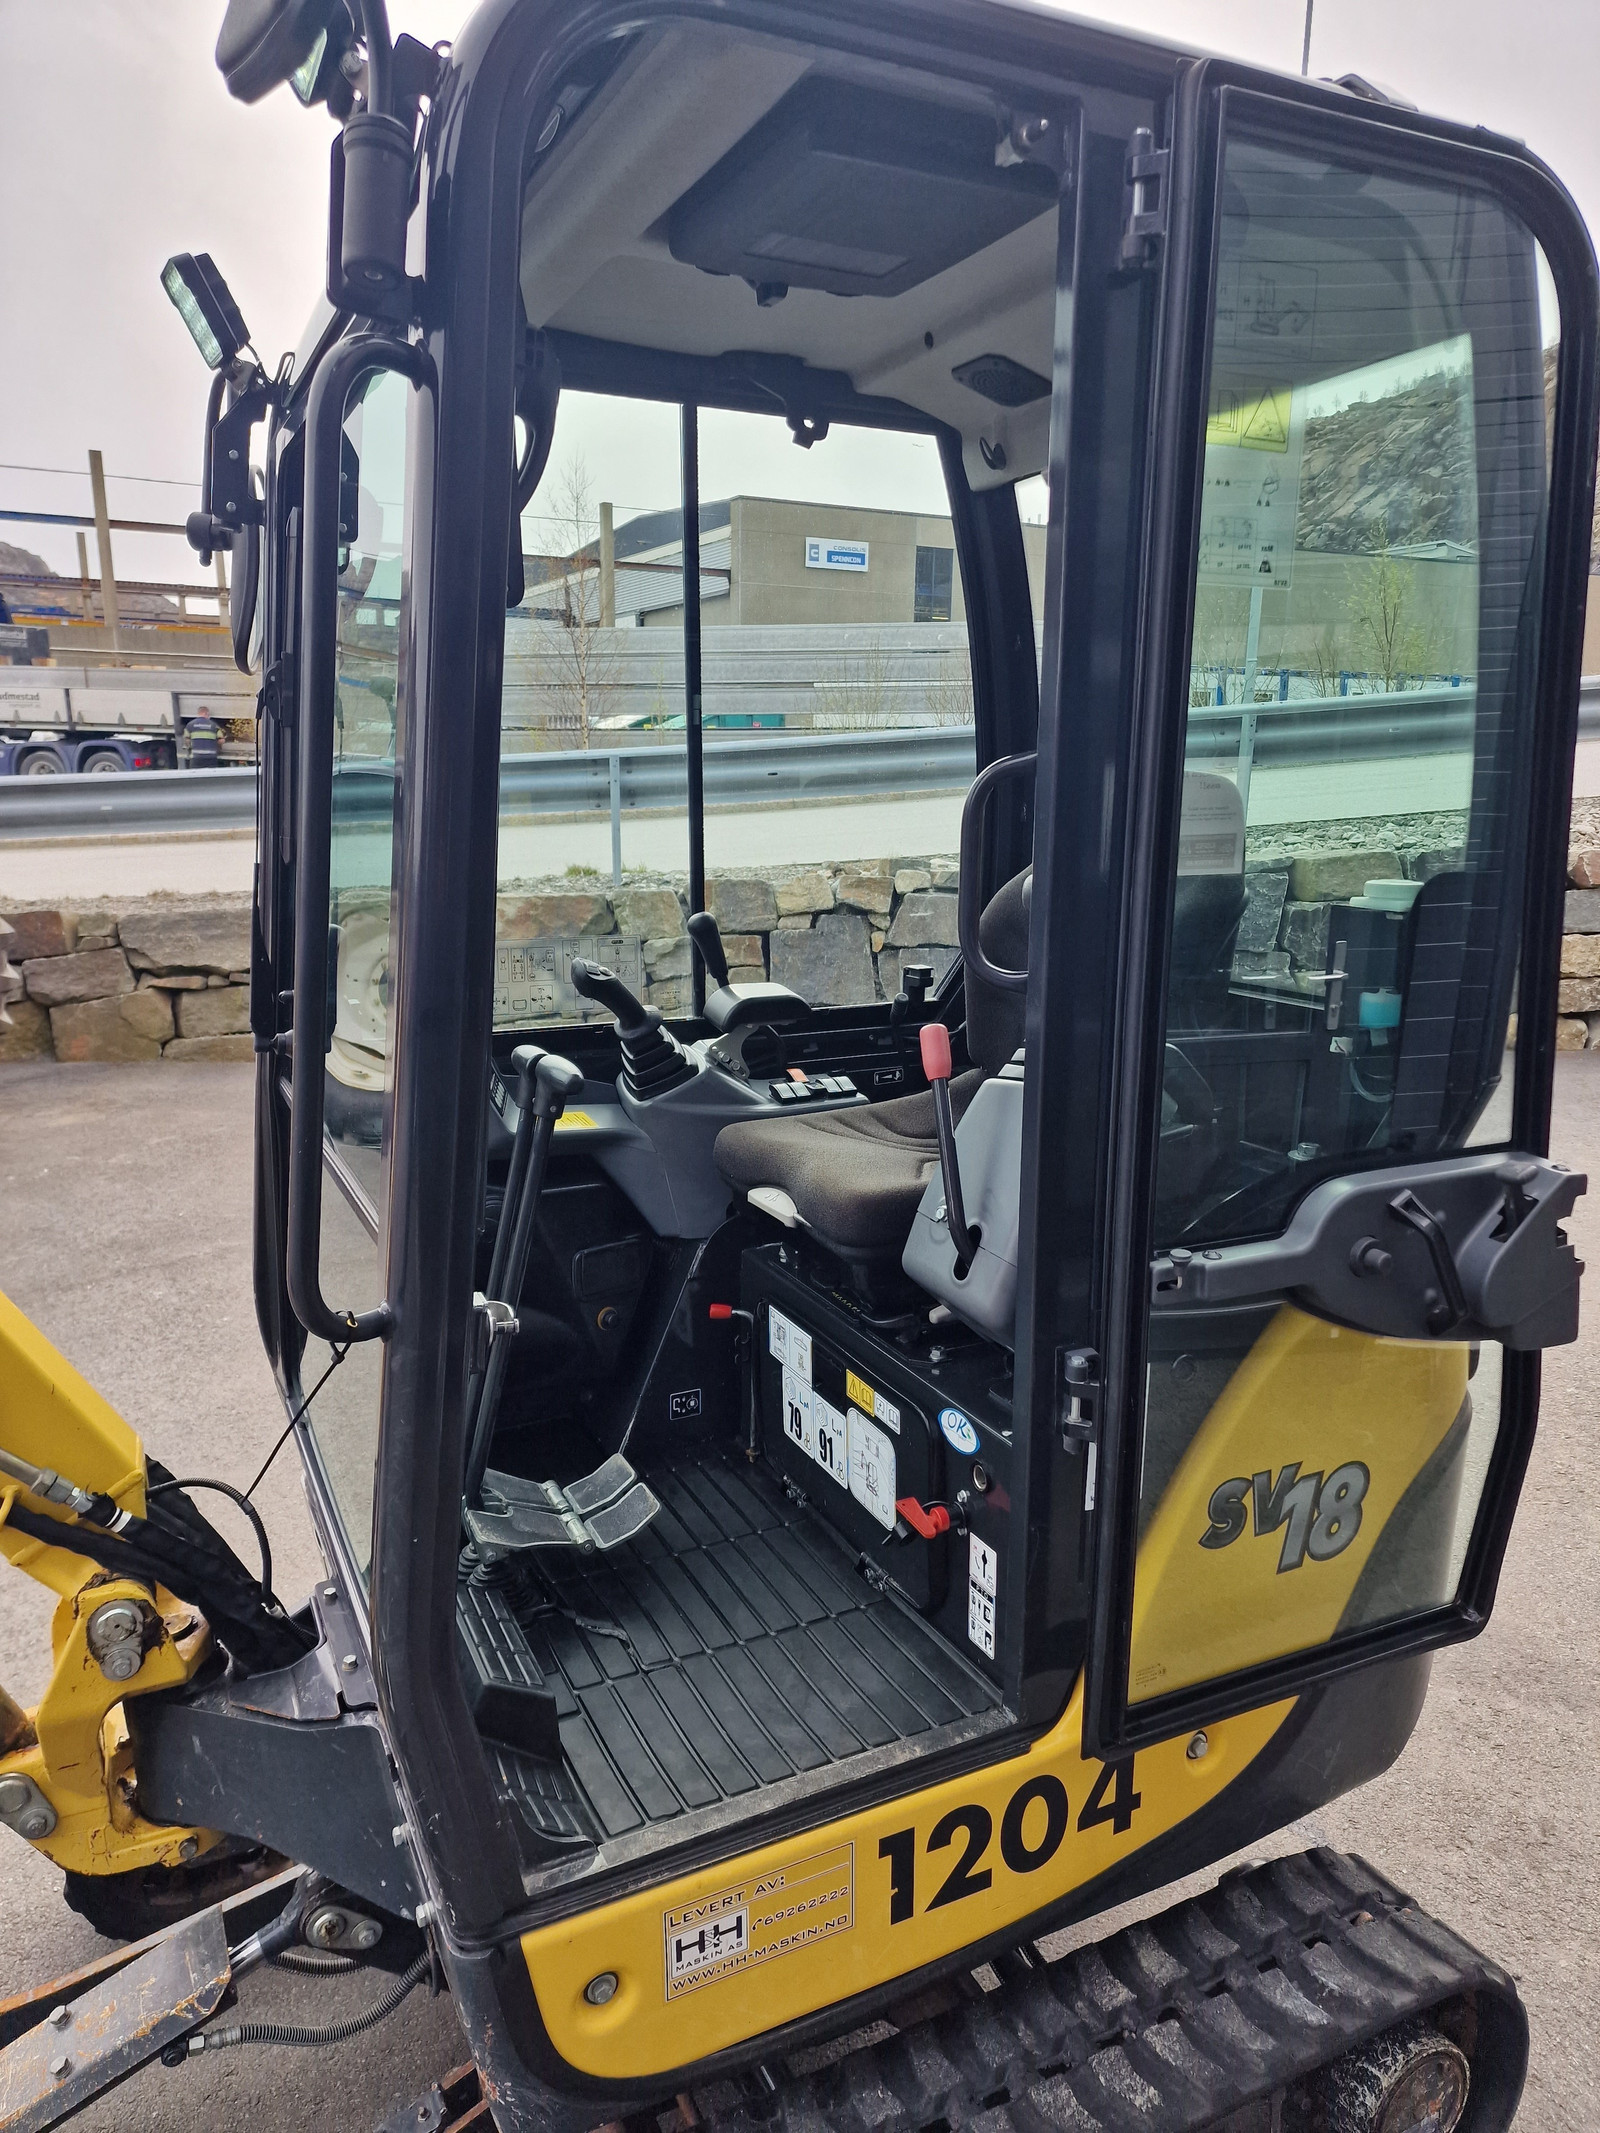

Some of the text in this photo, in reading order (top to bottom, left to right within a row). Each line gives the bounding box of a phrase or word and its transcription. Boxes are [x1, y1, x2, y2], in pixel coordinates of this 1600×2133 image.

[788, 1400, 802, 1440] 79
[819, 1427, 834, 1470] 91
[1198, 1460, 1371, 1575] SV18
[878, 1752, 1142, 1926] 1204
[669, 1875, 786, 1929] LEVERT AV:
[764, 1886, 849, 1926] 69262222
[672, 1914, 849, 1991] WWW.HH-MASKIN.NO
[675, 1940, 744, 1973] MASKIN AS
